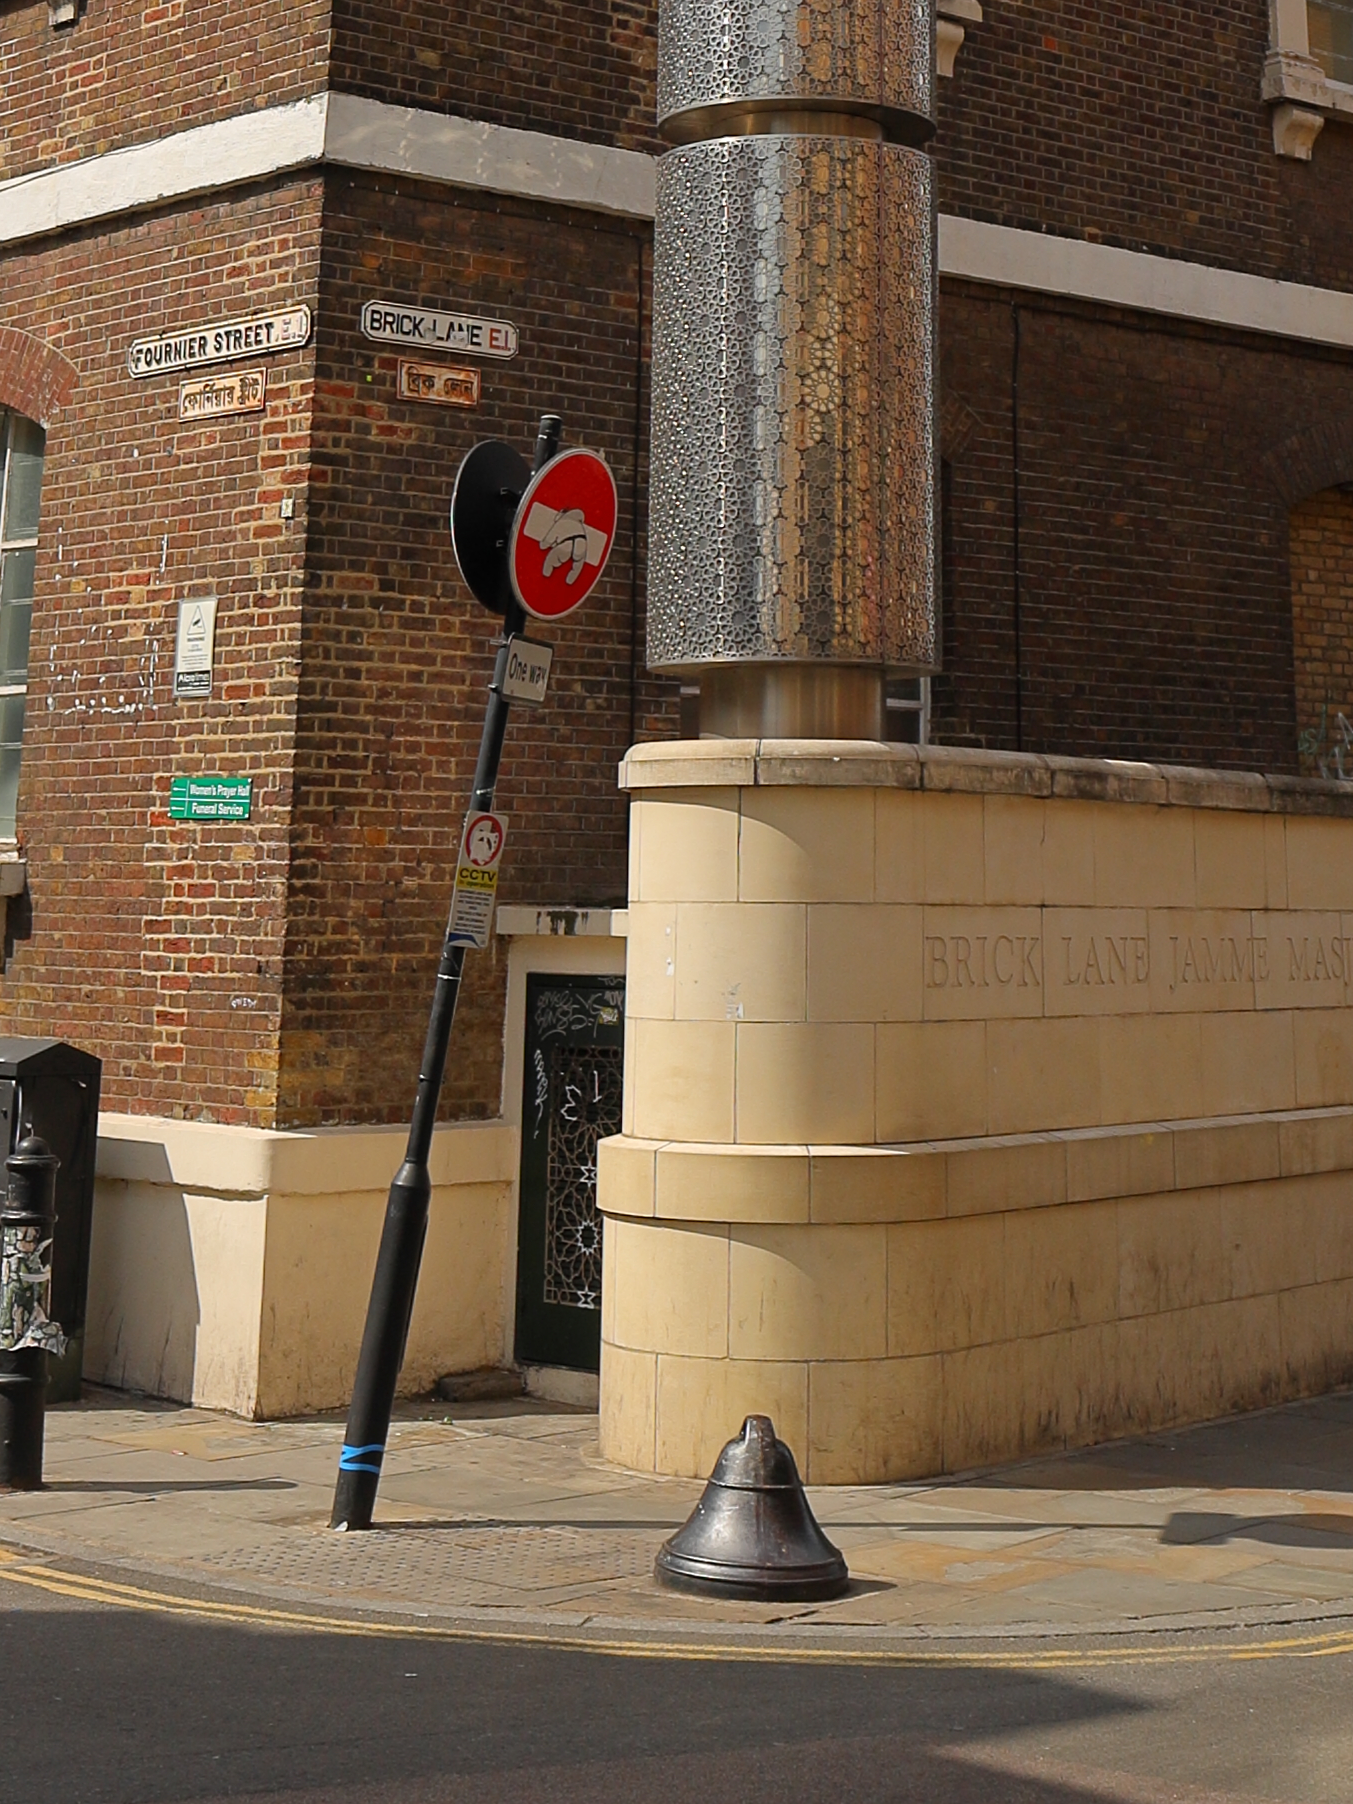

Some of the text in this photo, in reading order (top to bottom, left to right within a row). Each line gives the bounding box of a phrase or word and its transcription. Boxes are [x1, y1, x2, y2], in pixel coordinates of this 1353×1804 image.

[369, 309, 425, 339] BRICK
[132, 334, 208, 370] FOURNIER
[509, 652, 528, 683] One
[190, 783, 250, 799] Women's Prayer Hall
[191, 802, 244, 816] Funeral Service
[459, 867, 496, 882] CCTV
[925, 935, 1042, 989] BRICK
[1061, 935, 1148, 987] LANE
[1169, 935, 1271, 994] JAMME
